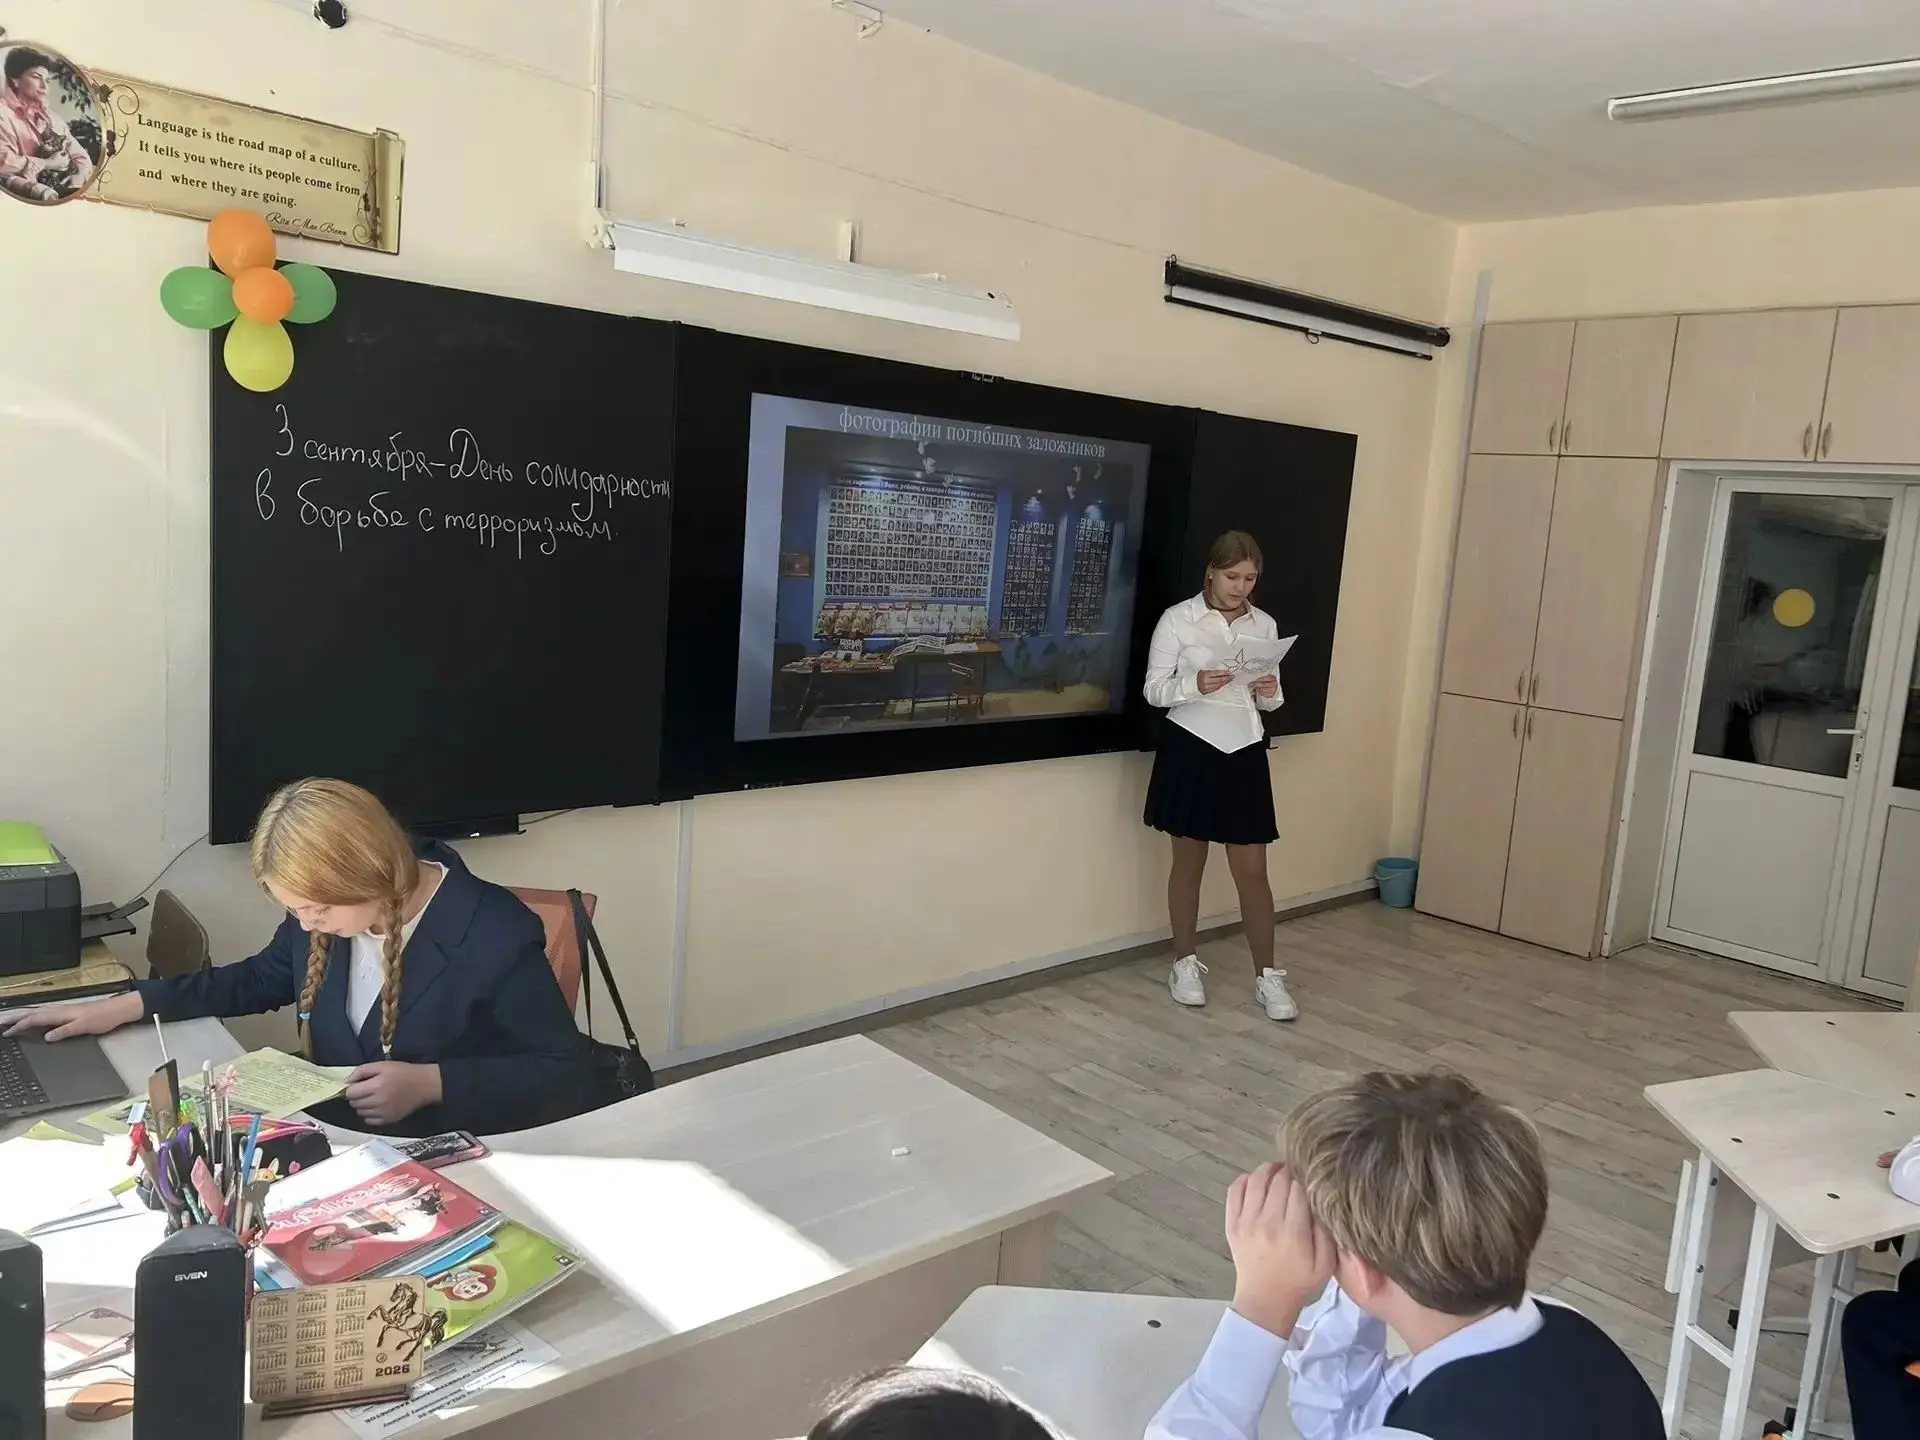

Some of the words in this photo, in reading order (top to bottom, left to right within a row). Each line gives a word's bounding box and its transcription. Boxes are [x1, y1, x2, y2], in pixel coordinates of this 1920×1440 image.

[137, 114, 198, 137] Language
[202, 128, 212, 139] is
[216, 132, 235, 144] the
[238, 138, 264, 151] road
[268, 145, 292, 159] map
[295, 149, 306, 160] of
[309, 154, 316, 162] a
[319, 156, 361, 172] culture.
[139, 140, 149, 152] It
[154, 144, 180, 158] tells
[183, 152, 205, 164] you
[209, 157, 245, 171] where
[249, 163, 263, 176] its
[265, 169, 302, 184] people
[304, 177, 332, 189] come
[335, 181, 361, 196] from
[138, 168, 162, 180] and
[170, 174, 208, 189] where
[211, 181, 238, 197] they
[240, 188, 259, 199] are
[262, 192, 297, 208] going.
[265, 211, 290, 226] Rita
[839, 407, 941, 441] фотографии
[945, 425, 1022, 449] погибших
[1026, 434, 1106, 458] заложников
[276, 403, 294, 456] 3
[526, 461, 671, 522] солидарности
[297, 478, 408, 552] борьбе
[419, 507, 434, 531] с
[445, 512, 619, 559] терроризмом.
[175, 1271, 208, 1282] SVEN
[375, 1364, 410, 1377] 2026
